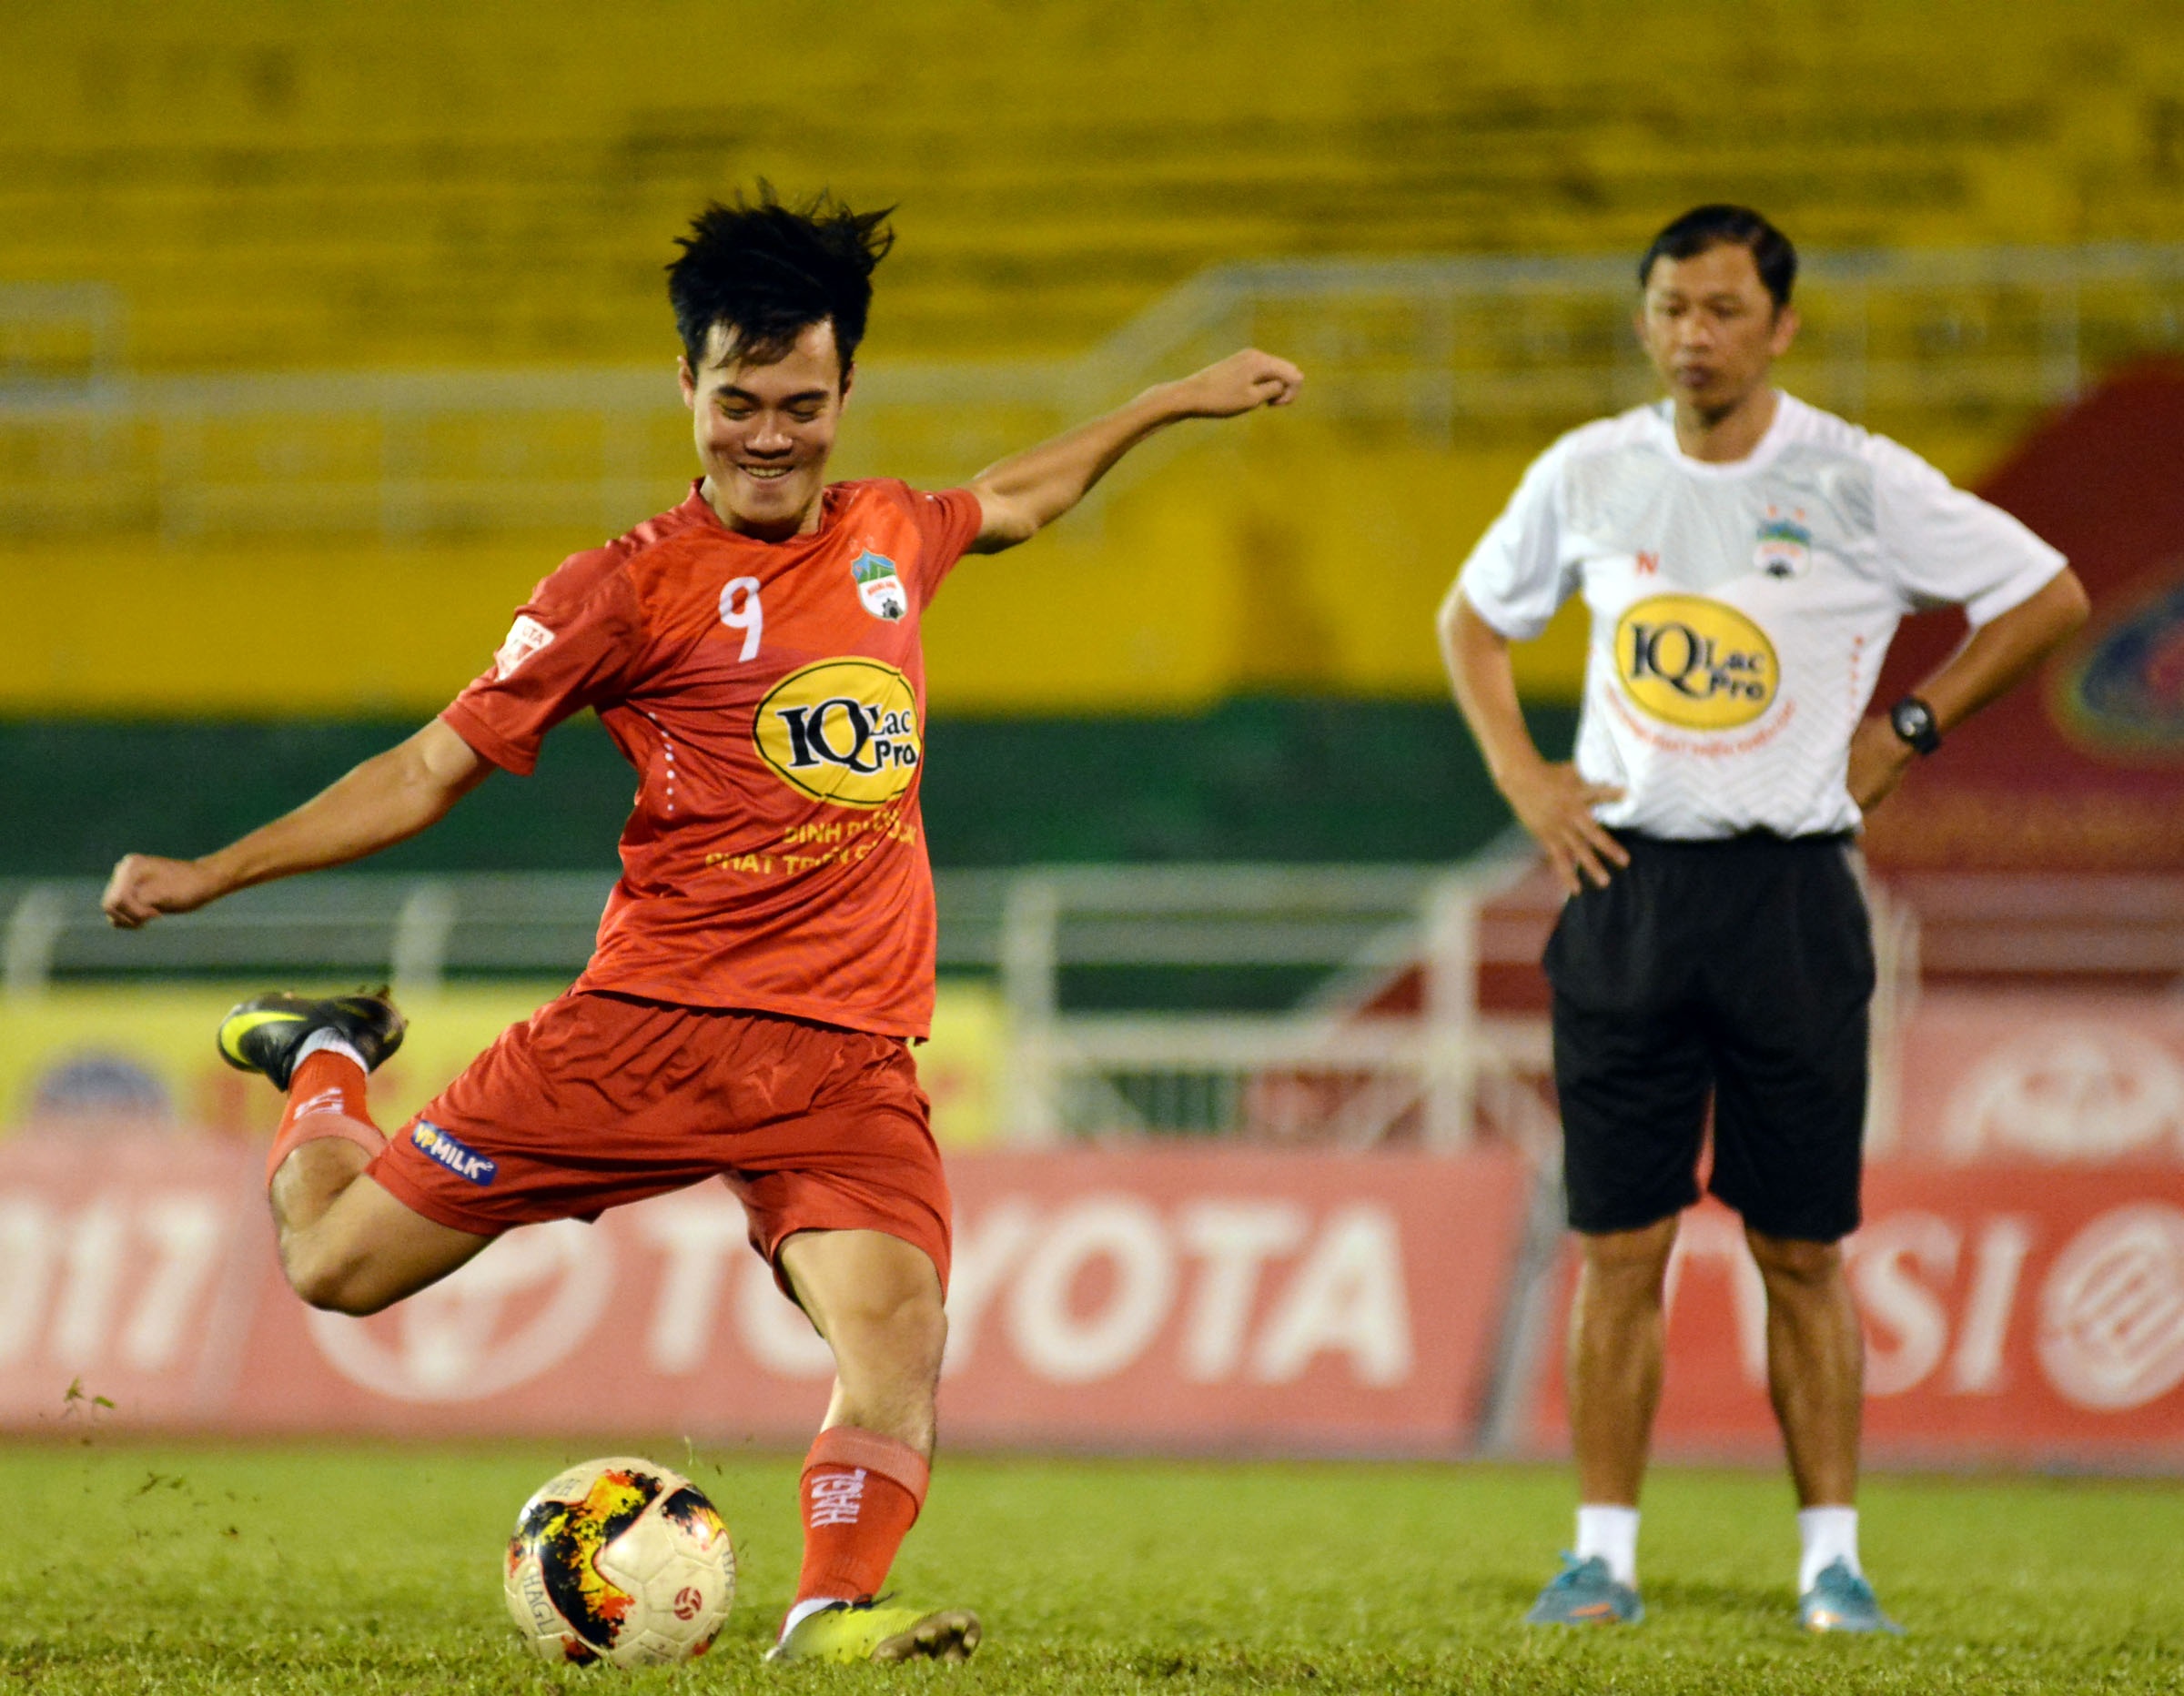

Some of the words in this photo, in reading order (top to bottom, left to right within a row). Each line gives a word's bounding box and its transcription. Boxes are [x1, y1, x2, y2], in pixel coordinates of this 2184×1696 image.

[719, 576, 763, 662] 9
[1631, 622, 1711, 699] IQ
[1704, 638, 1765, 672] Lac
[1710, 667, 1765, 701] Pro
[776, 698, 879, 773] IQ
[864, 704, 911, 736] Lac
[875, 739, 917, 769] Pro
[811, 1468, 867, 1529] HAGL
[523, 1573, 556, 1636] HAGL
